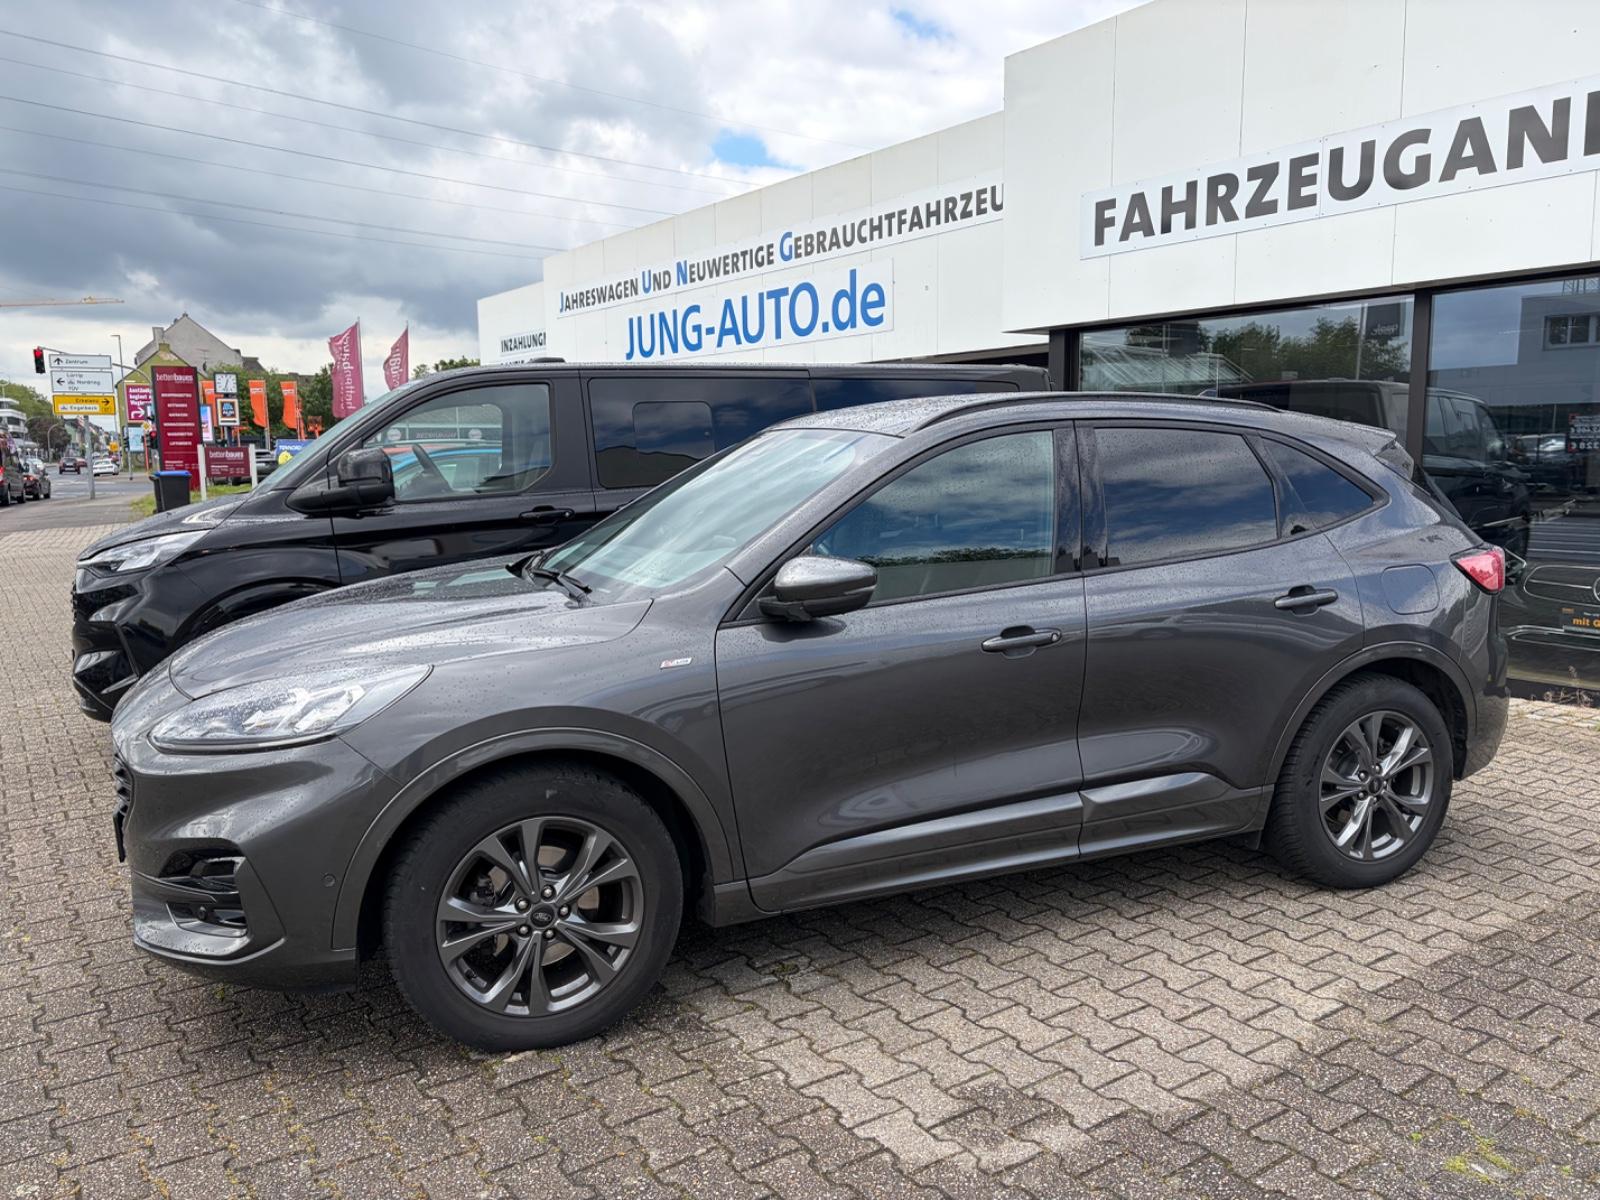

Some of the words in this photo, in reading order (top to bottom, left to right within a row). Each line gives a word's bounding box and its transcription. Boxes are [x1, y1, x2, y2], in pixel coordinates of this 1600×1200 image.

[559, 278, 639, 313] JAHRESWAGEN
[641, 269, 672, 294] UND
[676, 243, 775, 287] NEUWERTIGE
[625, 269, 886, 360] JUNG-AUTO.de
